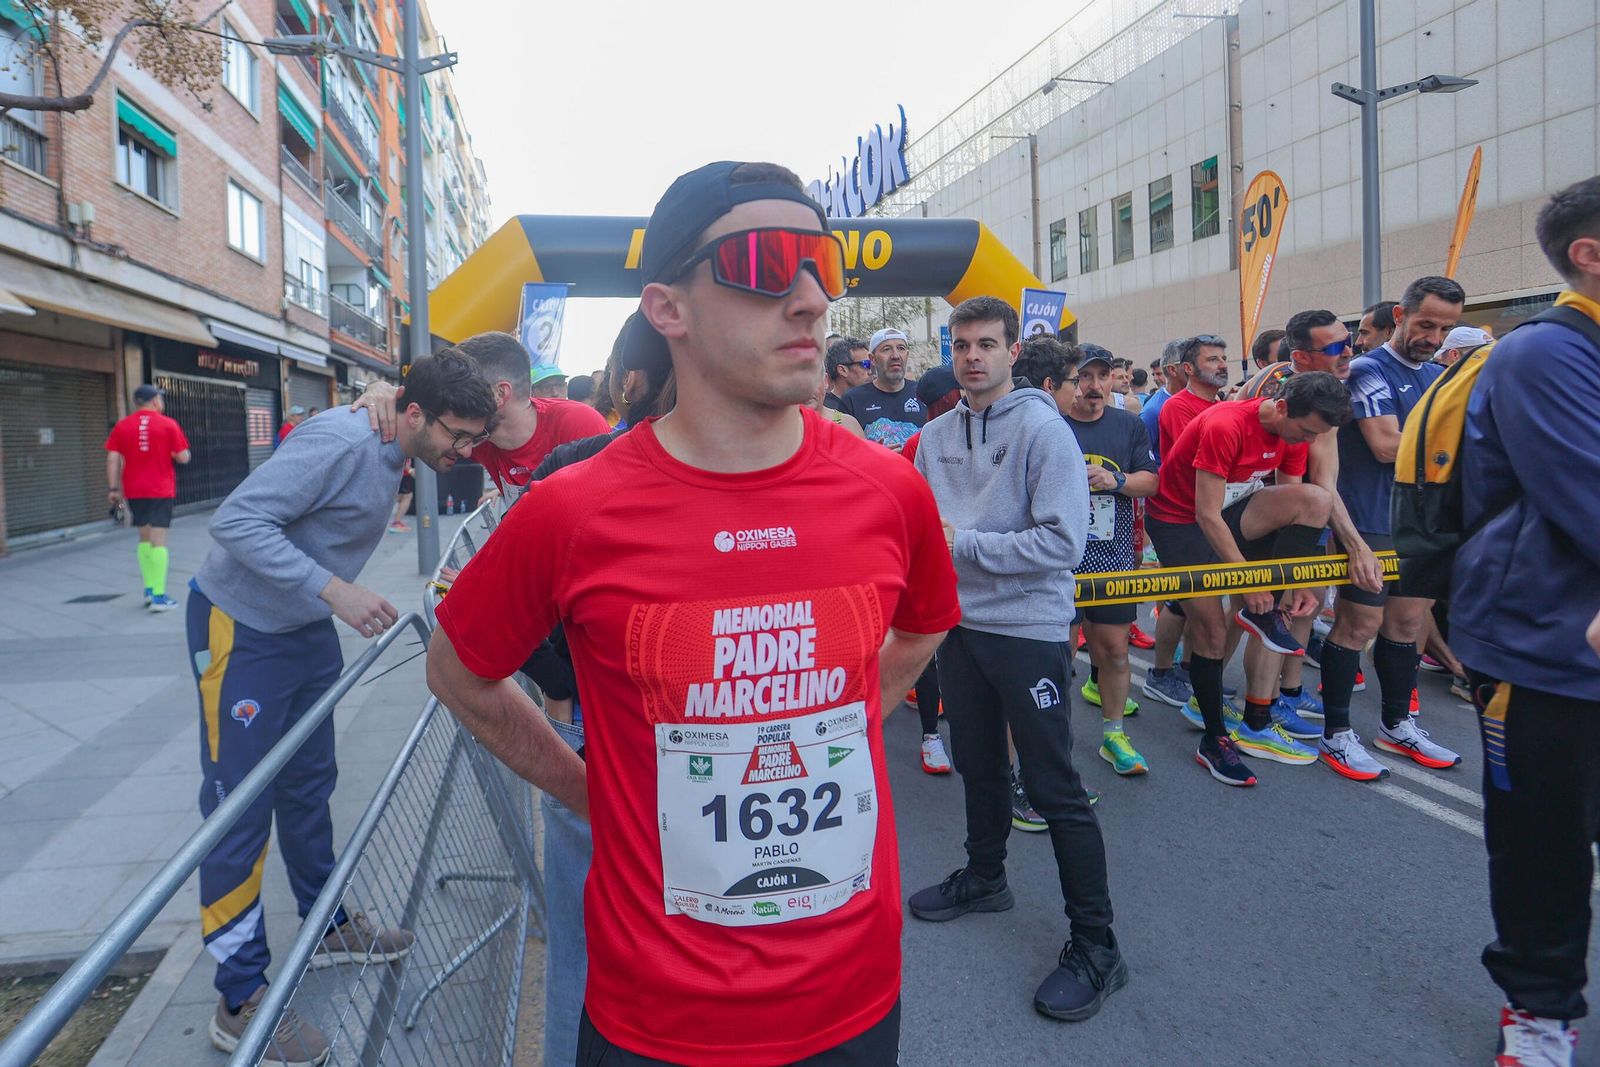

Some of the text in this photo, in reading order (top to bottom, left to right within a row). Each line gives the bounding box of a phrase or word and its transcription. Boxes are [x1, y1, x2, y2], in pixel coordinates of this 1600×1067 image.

[1026, 302, 1058, 317] CAJÓN
[736, 526, 796, 541] OXIMESA
[737, 539, 797, 551] NIPPON GASES
[1202, 568, 1272, 589] MARCELINO
[1292, 561, 1349, 581] ARCELINO
[1105, 575, 1181, 596] MARCELINO
[712, 600, 815, 636] MEMORIAL
[713, 627, 817, 680] PADRE
[684, 666, 846, 718] MARCELINO
[765, 723, 791, 733] CARRERA
[828, 713, 858, 728] OXIMESA
[684, 730, 729, 741] OXIMESA
[757, 731, 791, 744] POPULAR
[758, 743, 791, 755] MEMORIAL
[759, 751, 792, 769] PADRE
[748, 764, 801, 783] MARCELINO
[702, 782, 843, 843] 1632
[754, 842, 799, 859] PABLO
[756, 873, 797, 889] CAJÓN 1
[787, 895, 812, 910] eig
